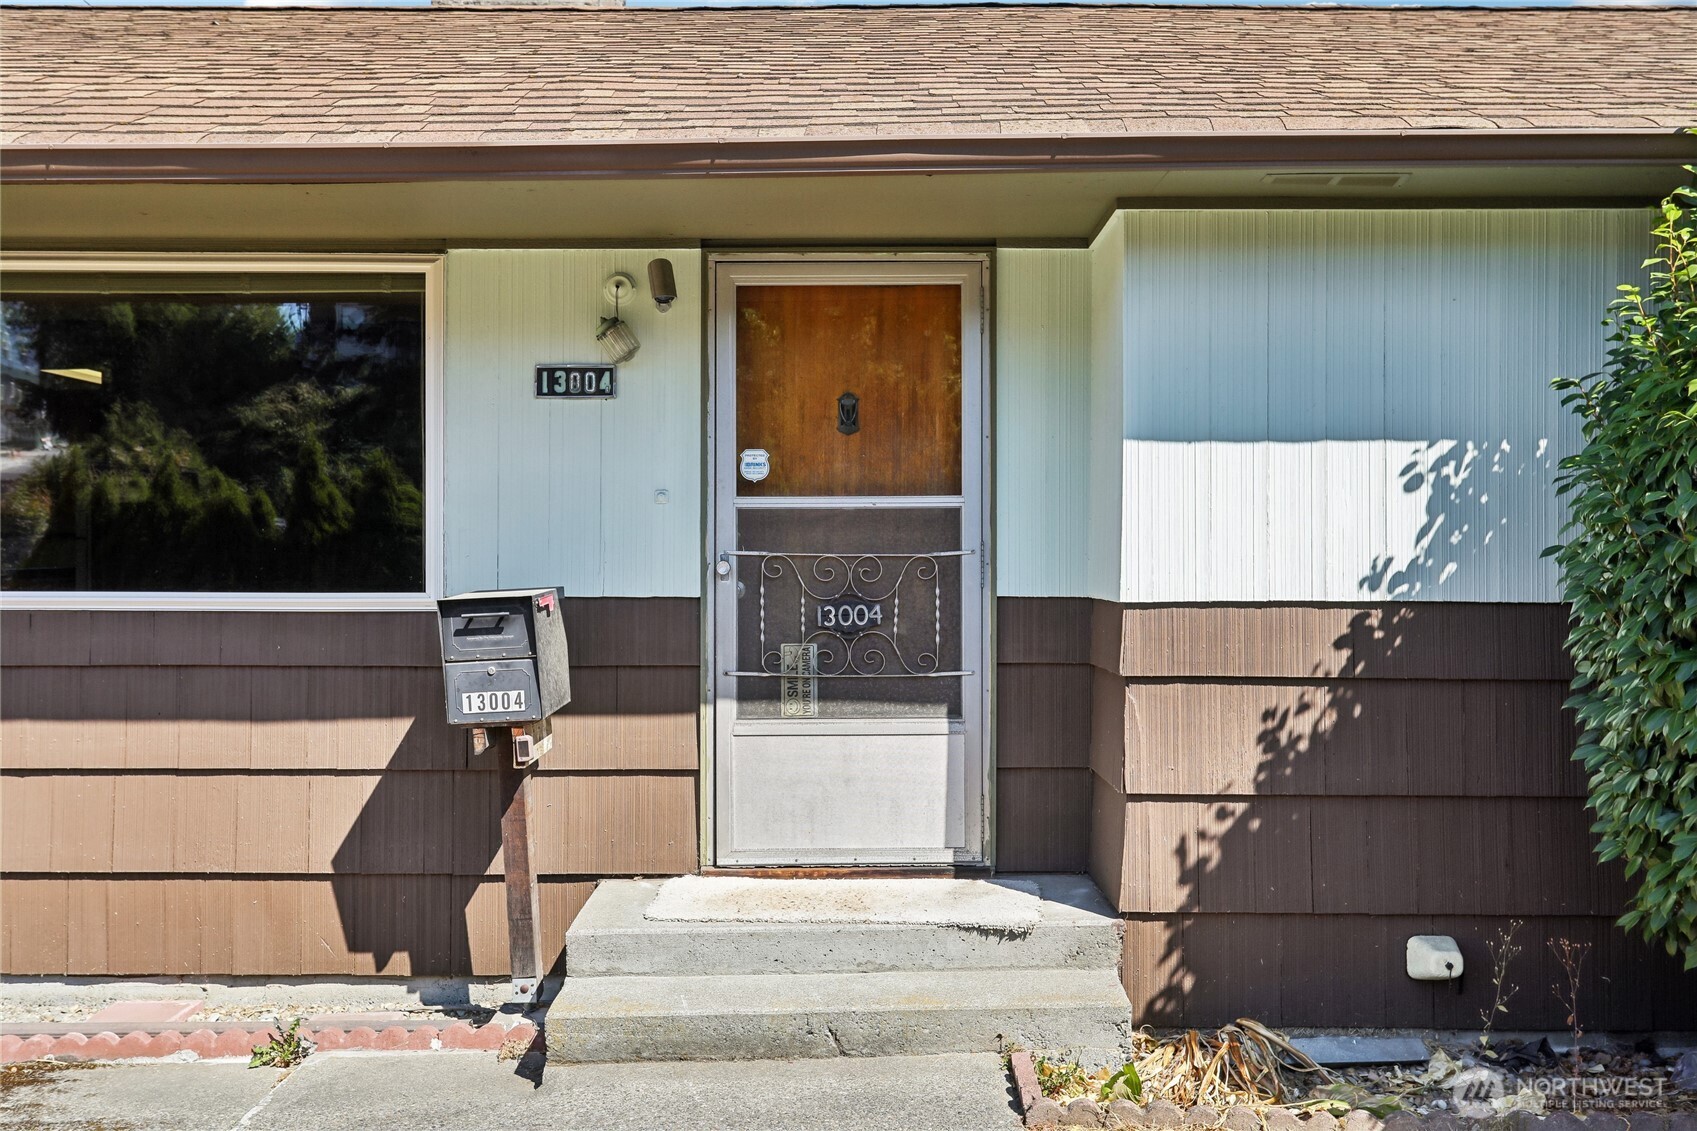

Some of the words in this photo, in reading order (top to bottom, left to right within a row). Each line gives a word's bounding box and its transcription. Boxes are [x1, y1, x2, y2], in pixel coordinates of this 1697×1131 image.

[542, 370, 611, 394] 13004
[817, 604, 883, 626] 13004
[802, 646, 811, 675] CAMERA
[802, 676, 811, 688] ON
[466, 691, 523, 712] 13004
